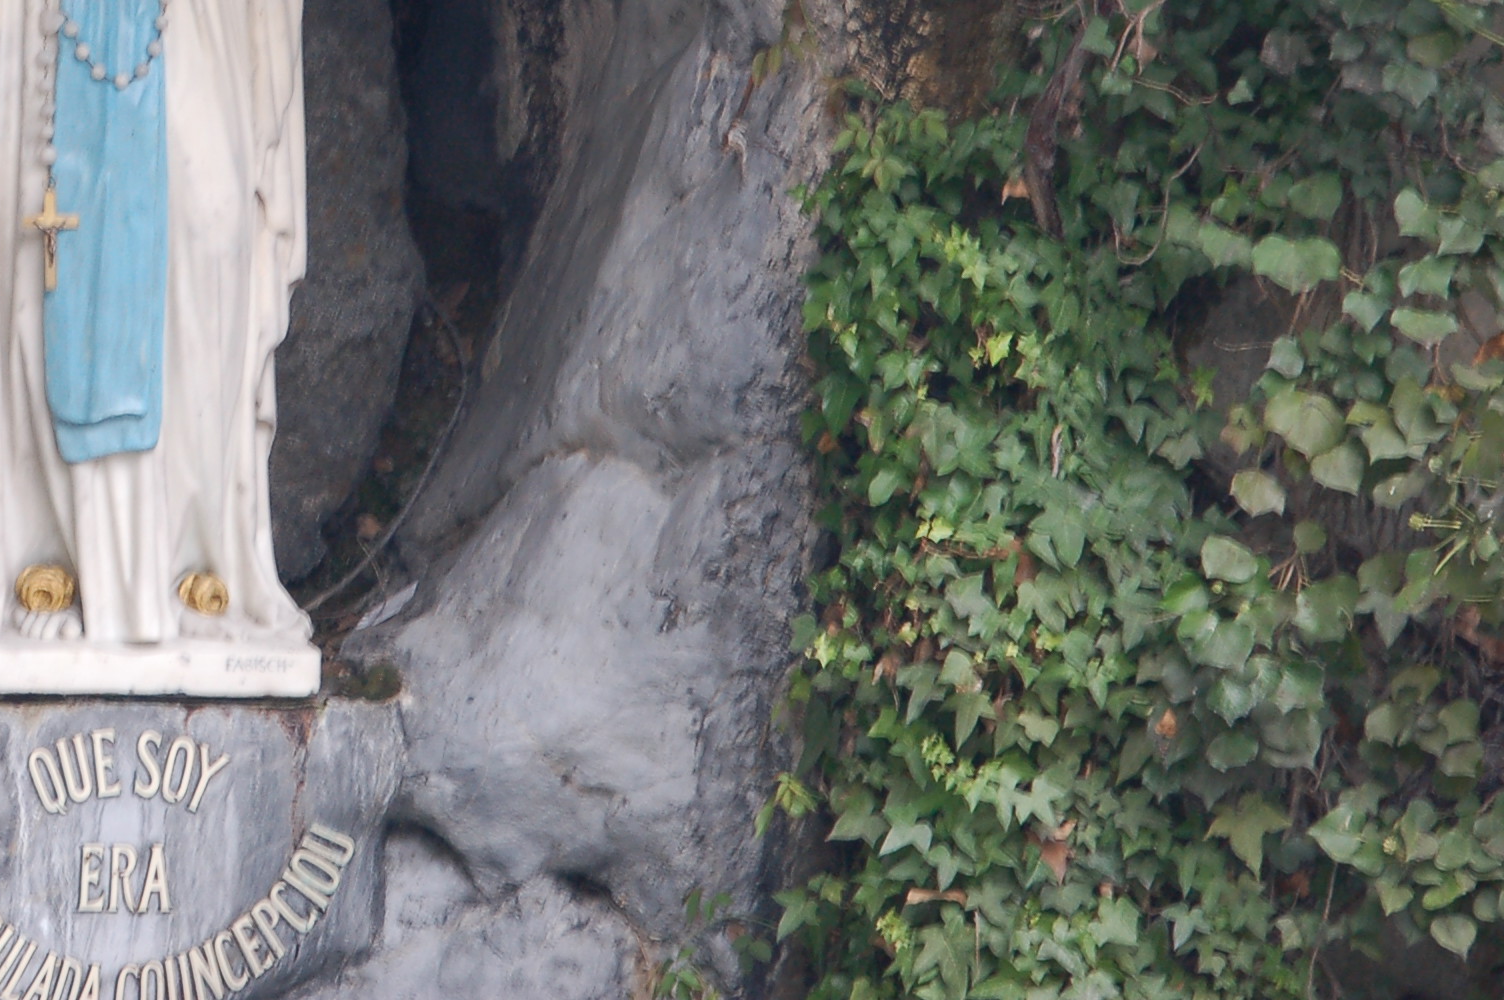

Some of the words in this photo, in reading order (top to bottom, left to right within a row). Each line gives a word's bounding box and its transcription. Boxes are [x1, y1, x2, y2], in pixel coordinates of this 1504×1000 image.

[28, 727, 121, 815] QUE
[133, 729, 230, 814] SOY
[76, 842, 172, 915] ERA
[113, 822, 356, 1000] COUNCEPCIOU
